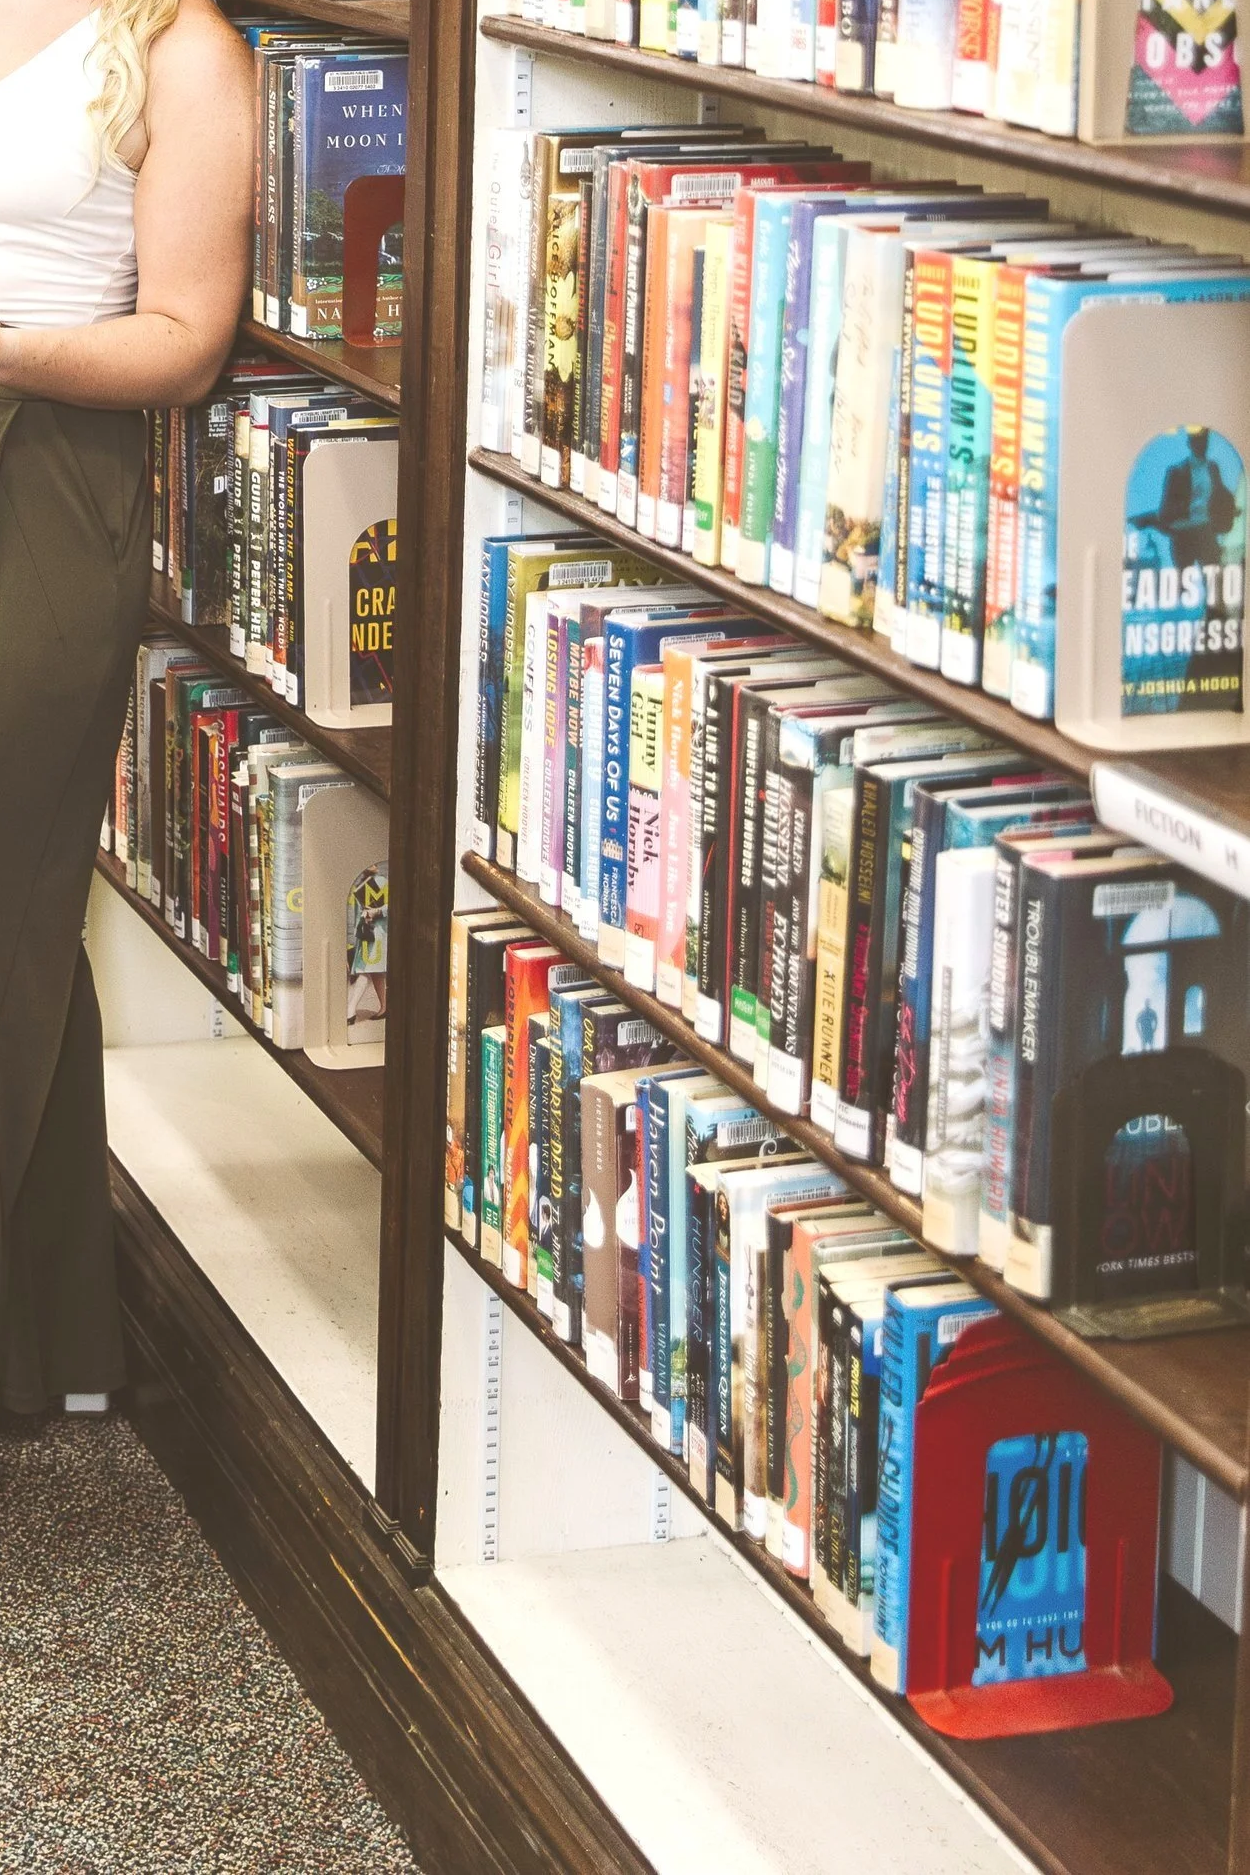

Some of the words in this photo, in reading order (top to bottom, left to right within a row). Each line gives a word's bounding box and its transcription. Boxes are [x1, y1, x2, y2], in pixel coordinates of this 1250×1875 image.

[342, 103, 404, 119] WHEN
[326, 133, 388, 149] MOON
[552, 210, 561, 262] ALICE
[734, 214, 747, 247] THE
[627, 245, 638, 289] BLACK
[548, 272, 558, 366] HOFFMAN
[626, 291, 637, 354] PANTHER
[732, 253, 747, 344] KILLING
[602, 320, 615, 377] Chuck
[728, 352, 744, 405] KIND
[950, 293, 978, 465] LUDLUM'S
[991, 302, 1020, 475] LUDLUM'S
[601, 385, 614, 443] Hogan
[234, 457, 242, 505] GUIDE
[251, 472, 260, 522] GUIDE
[232, 544, 241, 591] PETER
[958, 505, 974, 597] TREADSTONE
[251, 560, 260, 607] PETER
[356, 586, 396, 618] CRA
[545, 629, 557, 693] LOSING
[568, 642, 580, 698] MAYBE
[608, 635, 624, 699] SEVEN
[1137, 677, 1196, 696] JOSHUA
[1200, 676, 1239, 693] HOOD
[544, 699, 556, 747] HOPE
[568, 706, 578, 746] NOW
[607, 707, 621, 754] DAYS
[629, 691, 643, 739] Girl
[642, 697, 662, 773] Funny
[706, 707, 716, 718] A
[705, 725, 716, 763] LINE
[745, 719, 757, 816] MOONFLOWER
[543, 759, 551, 813] COLLEEN
[567, 769, 575, 820] COLLEEN
[606, 761, 619, 789] OF
[705, 772, 715, 790] TO
[606, 797, 619, 821] US
[704, 799, 715, 833] KILL
[776, 779, 792, 887] HOSSEINI
[1134, 796, 1204, 853] FICTION
[1224, 842, 1238, 870] H
[542, 818, 550, 865] HOOVER
[566, 826, 575, 873] HOOVER
[628, 804, 641, 892] Hornby
[642, 811, 660, 864] Nick
[740, 819, 753, 886] MURDERS
[793, 810, 806, 874] KHALED
[912, 828, 924, 891] CATHERINE
[601, 873, 609, 914] HORNAK
[610, 867, 619, 924] FRANCESCA
[701, 889, 711, 935] anthony
[790, 895, 799, 923] AND
[909, 894, 921, 924] RYAN
[995, 858, 1012, 923] AFTER
[737, 907, 748, 955] anthony
[906, 927, 919, 977] HOWARD
[701, 939, 711, 989] horowitz
[770, 912, 787, 1022] ECHOED
[821, 968, 834, 1011] KITE
[990, 928, 1009, 1029] SUNDOWN
[1021, 899, 1041, 1063] TROUBLEMAKER
[550, 1007, 560, 1034] THE
[785, 954, 800, 1055] MOUNTAINS
[549, 1037, 563, 1116] LIBRARY
[819, 1016, 834, 1085] RUNNER
[991, 1056, 1009, 1116] LINDA
[550, 1140, 562, 1198] DEAD
[650, 1103, 665, 1196] Haven
[988, 1126, 1007, 1212] HOWARD
[650, 1210, 665, 1294] Point
[1128, 1255, 1160, 1270] TIMES
[690, 1217, 702, 1342] HUNGER
[718, 1266, 728, 1373] JERUSALEM'S
[657, 1322, 666, 1395] VIRGINIA
[744, 1348, 757, 1382] Kind
[881, 1308, 903, 1407] KILLER
[718, 1377, 728, 1435] QUEEN
[743, 1387, 755, 1413] One
[850, 1356, 860, 1417] PRIVATE
[878, 1456, 900, 1555] CHOICE
[879, 1555, 887, 1592] TOM
[877, 1594, 887, 1637] HUNT
